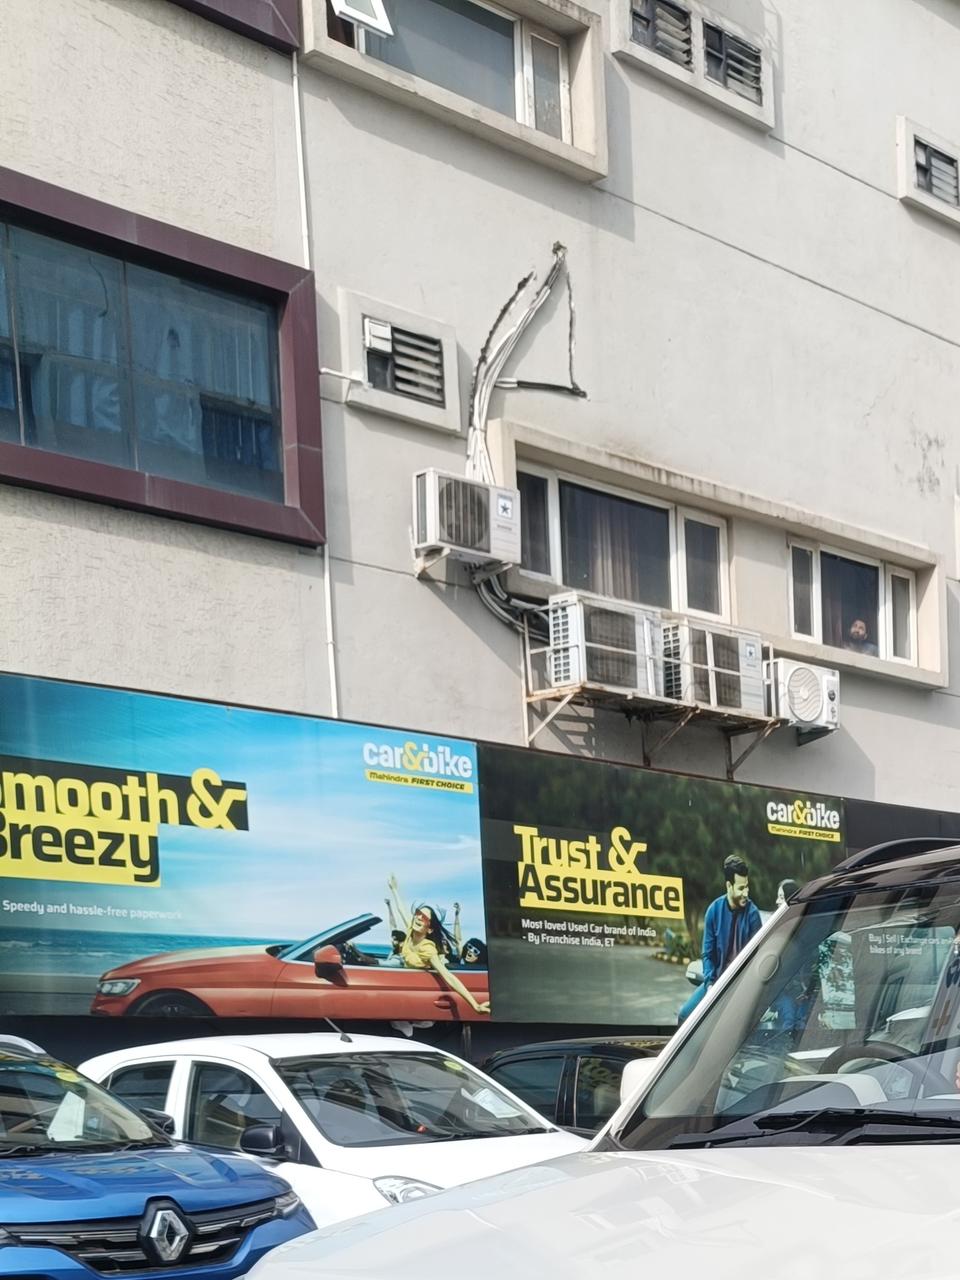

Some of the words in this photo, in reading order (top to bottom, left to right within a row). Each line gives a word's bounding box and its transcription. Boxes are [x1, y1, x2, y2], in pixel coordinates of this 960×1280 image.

[363, 741, 472, 778] car&bike
[0, 771, 180, 825] mooth
[186, 768, 247, 832] &
[411, 778, 435, 787] FIRST
[436, 780, 465, 790] CHOICE
[766, 800, 840, 829] car&bike
[0, 811, 160, 882] reezy
[513, 825, 601, 869] Trust
[608, 826, 647, 874] &
[520, 864, 680, 912] Assurance
[3, 900, 44, 915] Speedy
[47, 903, 67, 914] and
[70, 904, 128, 917] hassle-free
[130, 909, 182, 920] paperwork
[521, 919, 543, 929] Most
[545, 920, 566, 931] loved
[568, 922, 588, 933] Used
[590, 924, 603, 933] Car
[605, 924, 627, 935] brand
[628, 926, 636, 936] of
[638, 927, 656, 937] India
[528, 933, 540, 944] By
[541, 933, 580, 945] Franchise
[581, 936, 604, 947] India,
[605, 937, 615, 947] ET
